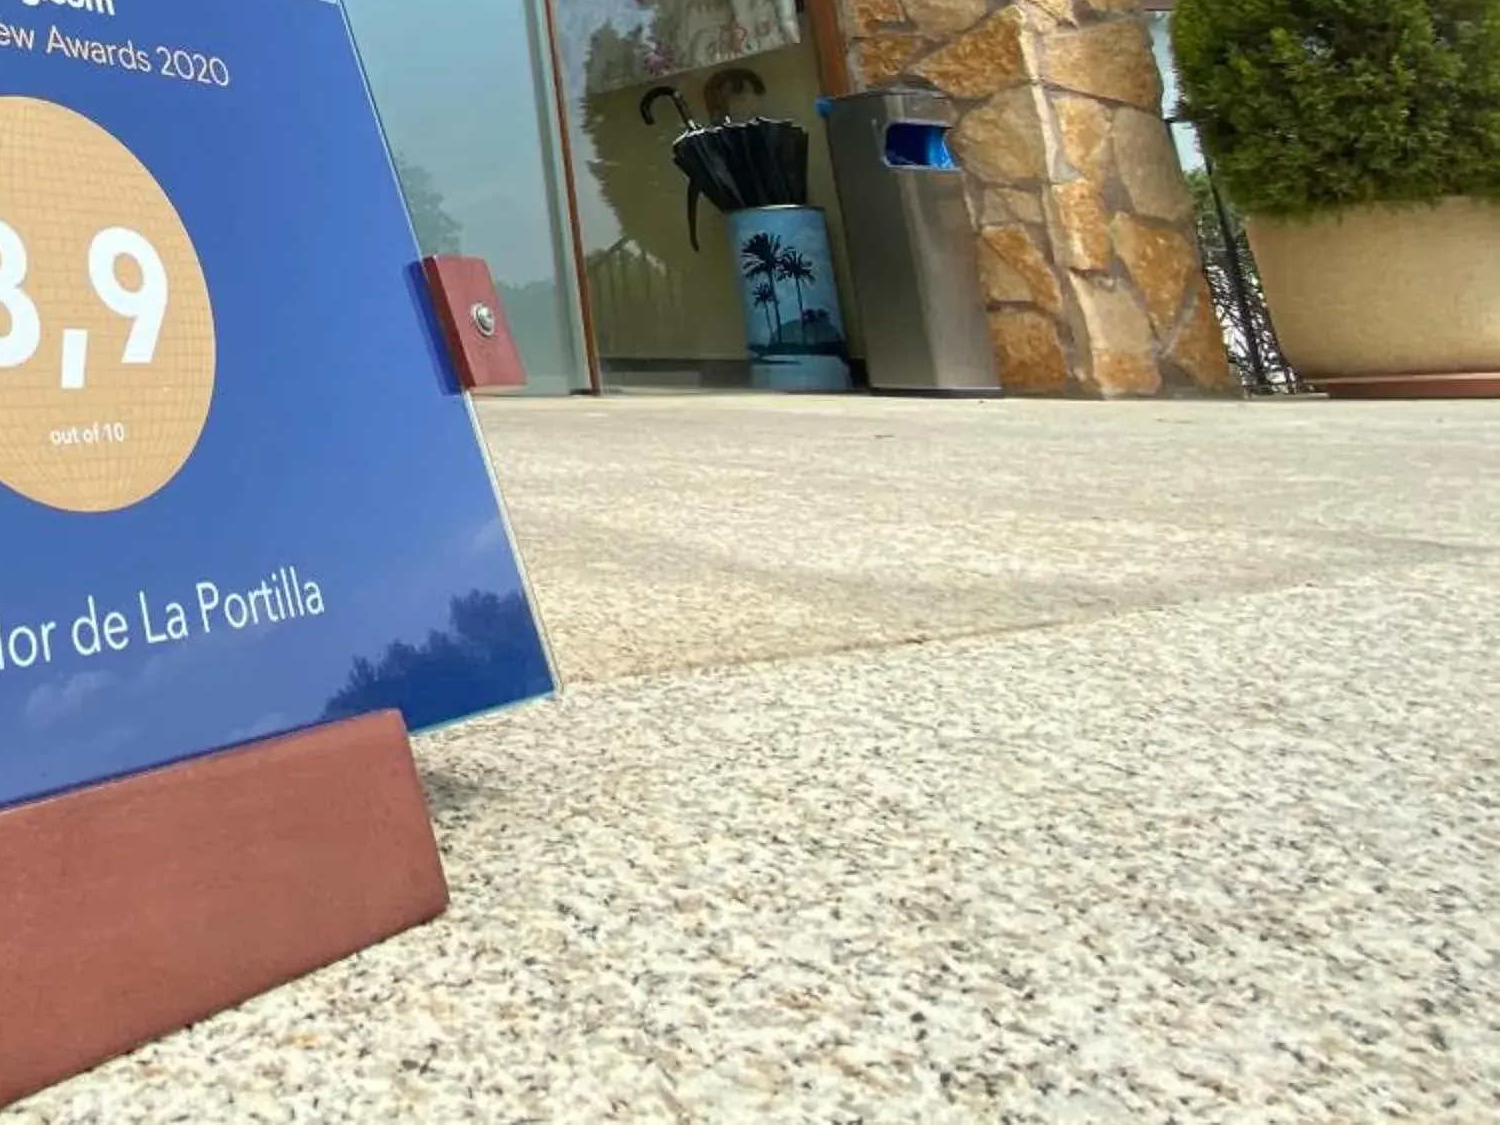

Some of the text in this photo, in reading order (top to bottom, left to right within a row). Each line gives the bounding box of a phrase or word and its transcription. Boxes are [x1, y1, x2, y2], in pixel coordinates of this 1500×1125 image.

[46, 24, 152, 73] Awards
[155, 46, 230, 88] 2020
[49, 420, 125, 446] out of 10
[71, 594, 130, 656] de
[139, 590, 190, 644] La
[195, 565, 326, 634] Portilla
